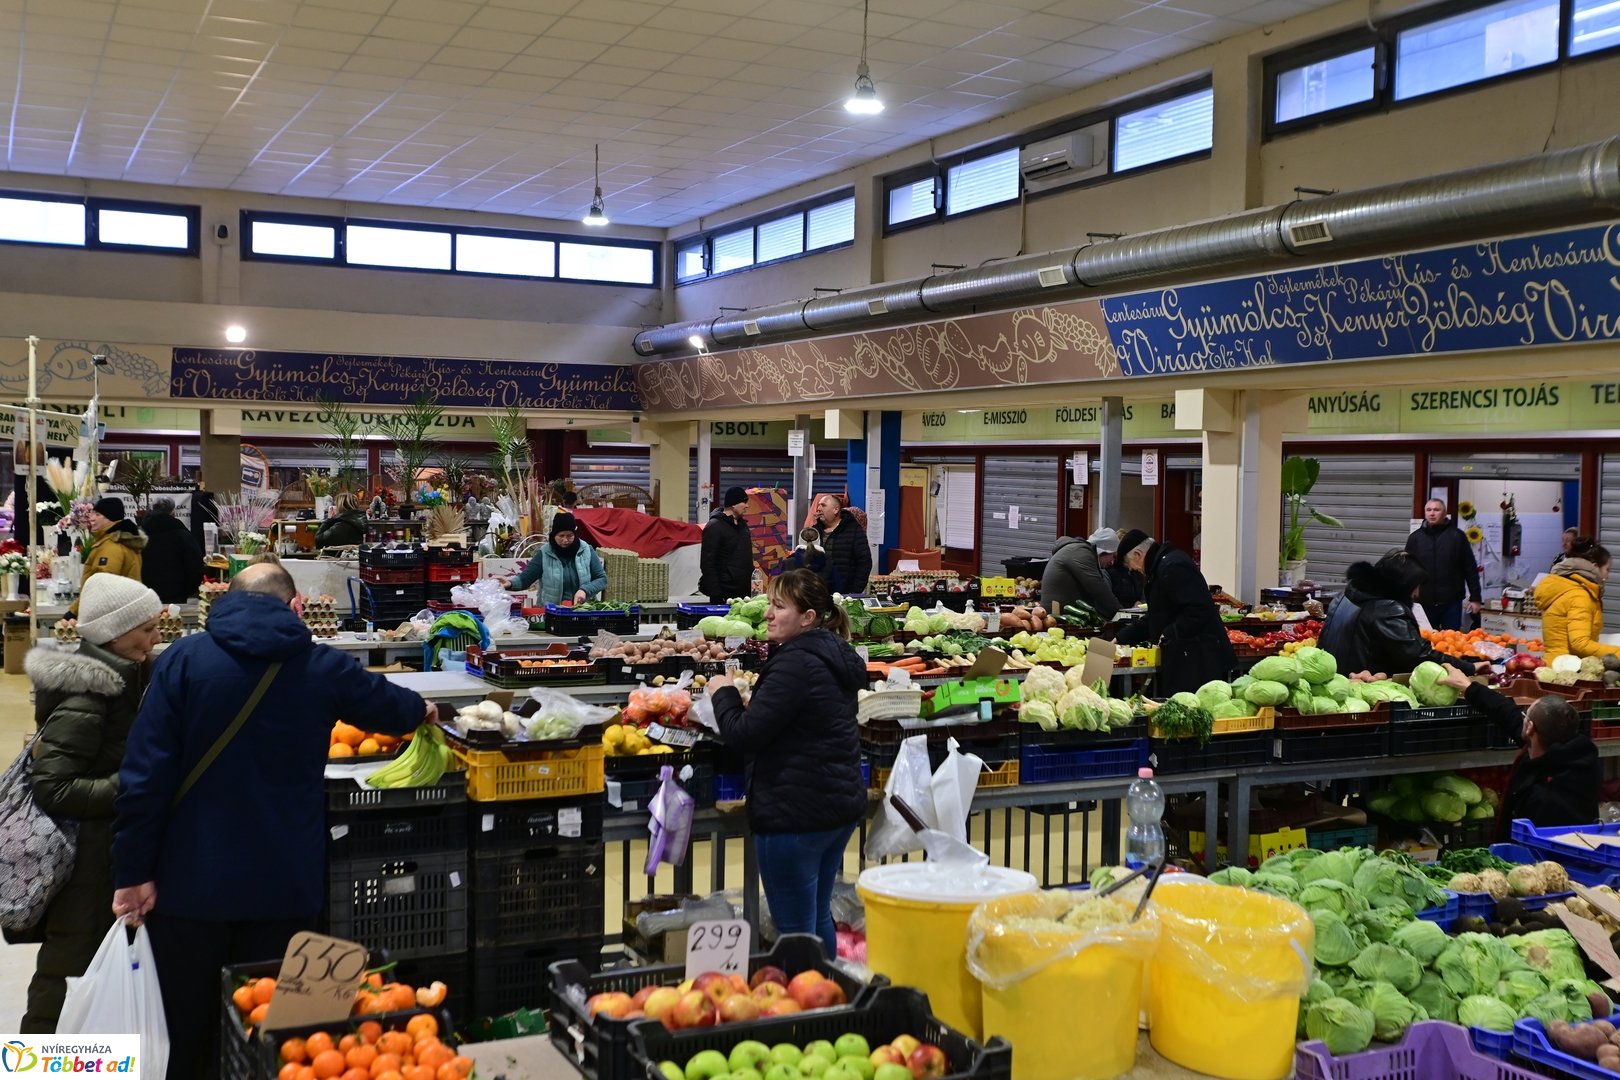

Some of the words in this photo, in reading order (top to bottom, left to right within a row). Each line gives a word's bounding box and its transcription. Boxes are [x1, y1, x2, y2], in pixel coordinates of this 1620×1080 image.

[1450, 258, 1471, 278] és
[1476, 240, 1607, 276] Hentesáru
[1266, 265, 1344, 302] Tejtermékek
[1161, 281, 1298, 358] Gyümölcs
[1304, 291, 1409, 347] Kenyér
[1402, 282, 1535, 351] Zöldség
[1524, 279, 1620, 341] Vir
[1122, 328, 1208, 374] Virág
[1235, 338, 1276, 368] Hal
[1297, 312, 1334, 361] Tej
[184, 368, 259, 401] Virág
[235, 350, 350, 392] Gyümölcs
[461, 364, 472, 376] és
[495, 379, 560, 409] Virág
[1411, 388, 1498, 411] SZERENCSI
[1503, 382, 1559, 407] TOJÁS
[1590, 383, 1620, 404] TE
[983, 408, 1028, 425] E-MISSZIÓ
[1055, 405, 1097, 423] FÖLDESI
[691, 924, 742, 952] 299
[281, 937, 367, 983] 550
